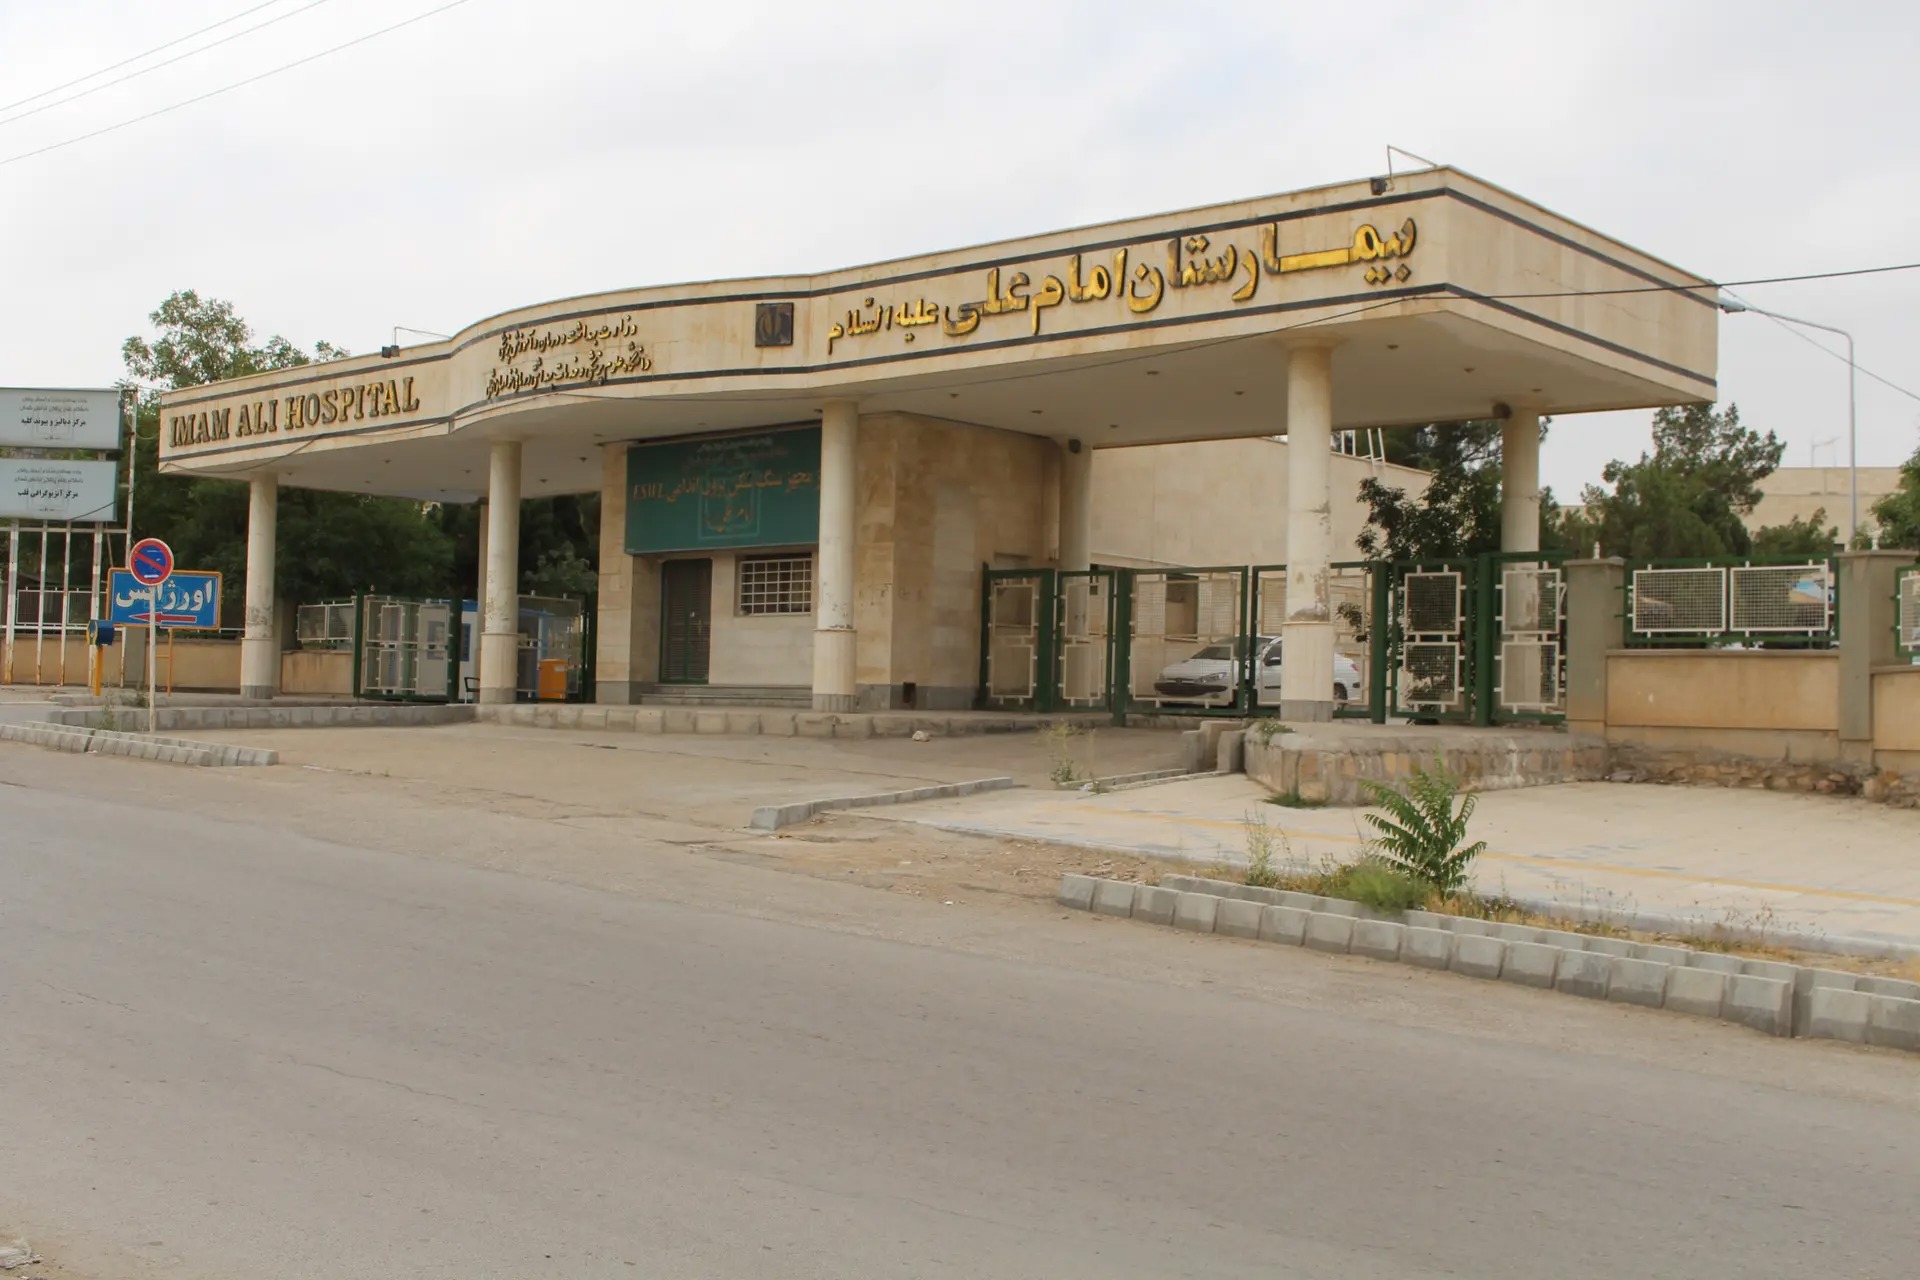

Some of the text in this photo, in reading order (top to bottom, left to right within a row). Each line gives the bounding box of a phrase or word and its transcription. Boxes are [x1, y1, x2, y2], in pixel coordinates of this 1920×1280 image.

[1032, 247, 1128, 336] امام
[1128, 218, 1417, 313] بیمارستان
[895, 299, 939, 343] علیه
[943, 267, 1030, 336] علی
[168, 376, 420, 448] IMAM ALI HOSPITAL
[116, 579, 212, 611] اورژاس
